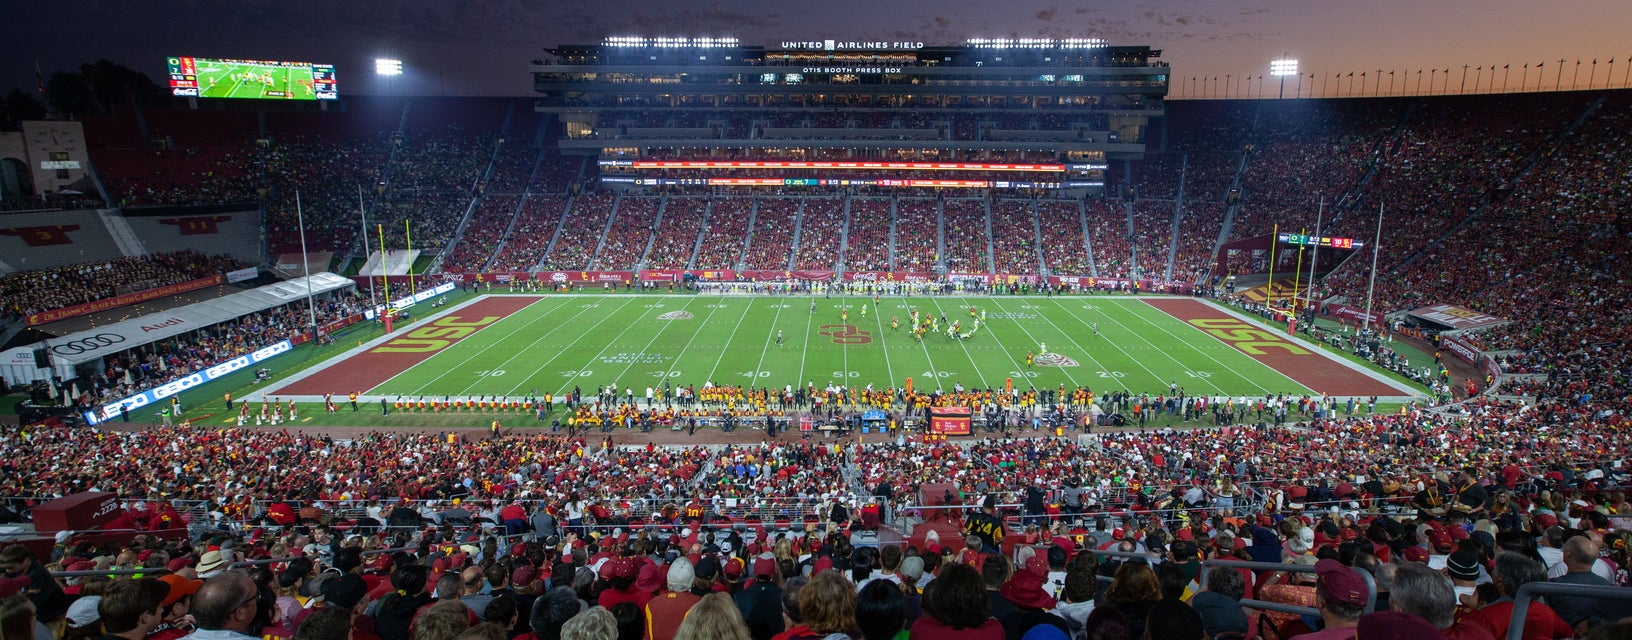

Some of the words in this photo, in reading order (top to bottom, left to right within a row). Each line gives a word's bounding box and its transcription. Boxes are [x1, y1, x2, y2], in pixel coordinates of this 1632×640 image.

[140, 318, 184, 333] Audi
[368, 316, 501, 353] USC
[1188, 318, 1312, 354] USC
[1444, 338, 1476, 362] POWERADE
[206, 356, 249, 379] GEICO
[152, 373, 202, 400] GEICO
[101, 502, 118, 516] 222B
